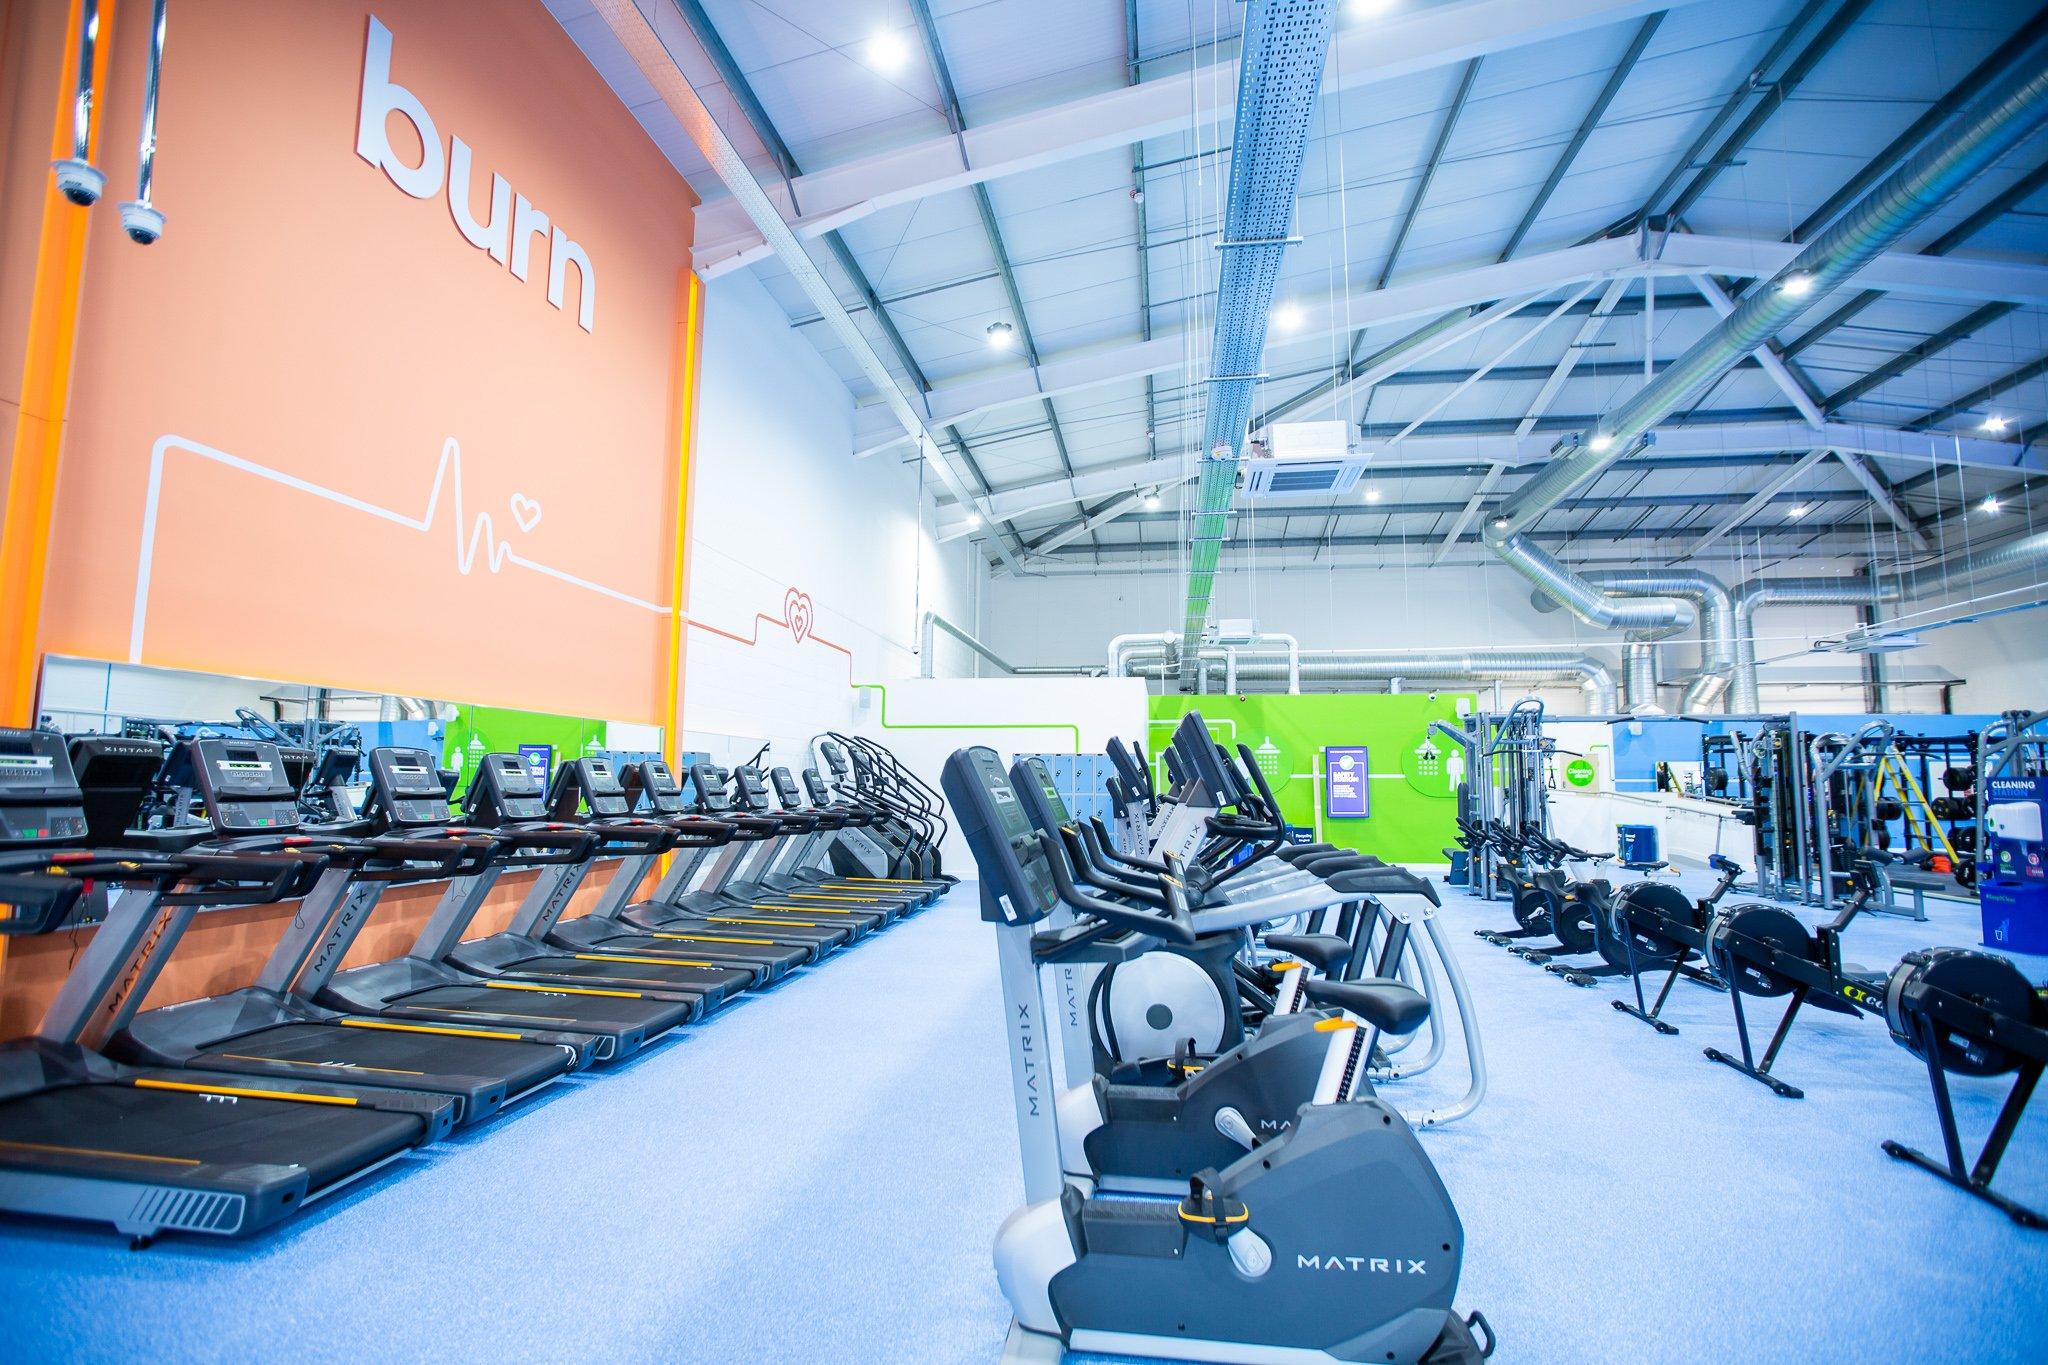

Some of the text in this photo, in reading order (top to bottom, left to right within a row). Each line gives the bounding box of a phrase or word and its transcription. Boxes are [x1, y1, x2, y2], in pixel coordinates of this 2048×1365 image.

[355, 13, 596, 334] burn
[1992, 781, 2036, 789] CLEANING
[1993, 788, 2028, 797] STATION
[1133, 813, 1145, 855] MATRIX
[1180, 824, 1201, 858] TRIX
[542, 864, 582, 921] MATRIX
[314, 889, 368, 972] MATRIX
[108, 912, 172, 1013] MATRIX
[1064, 967, 1078, 1027] MATR
[1018, 1003, 1040, 1116] MATRIX
[1297, 1254, 1427, 1275] MATRIX
